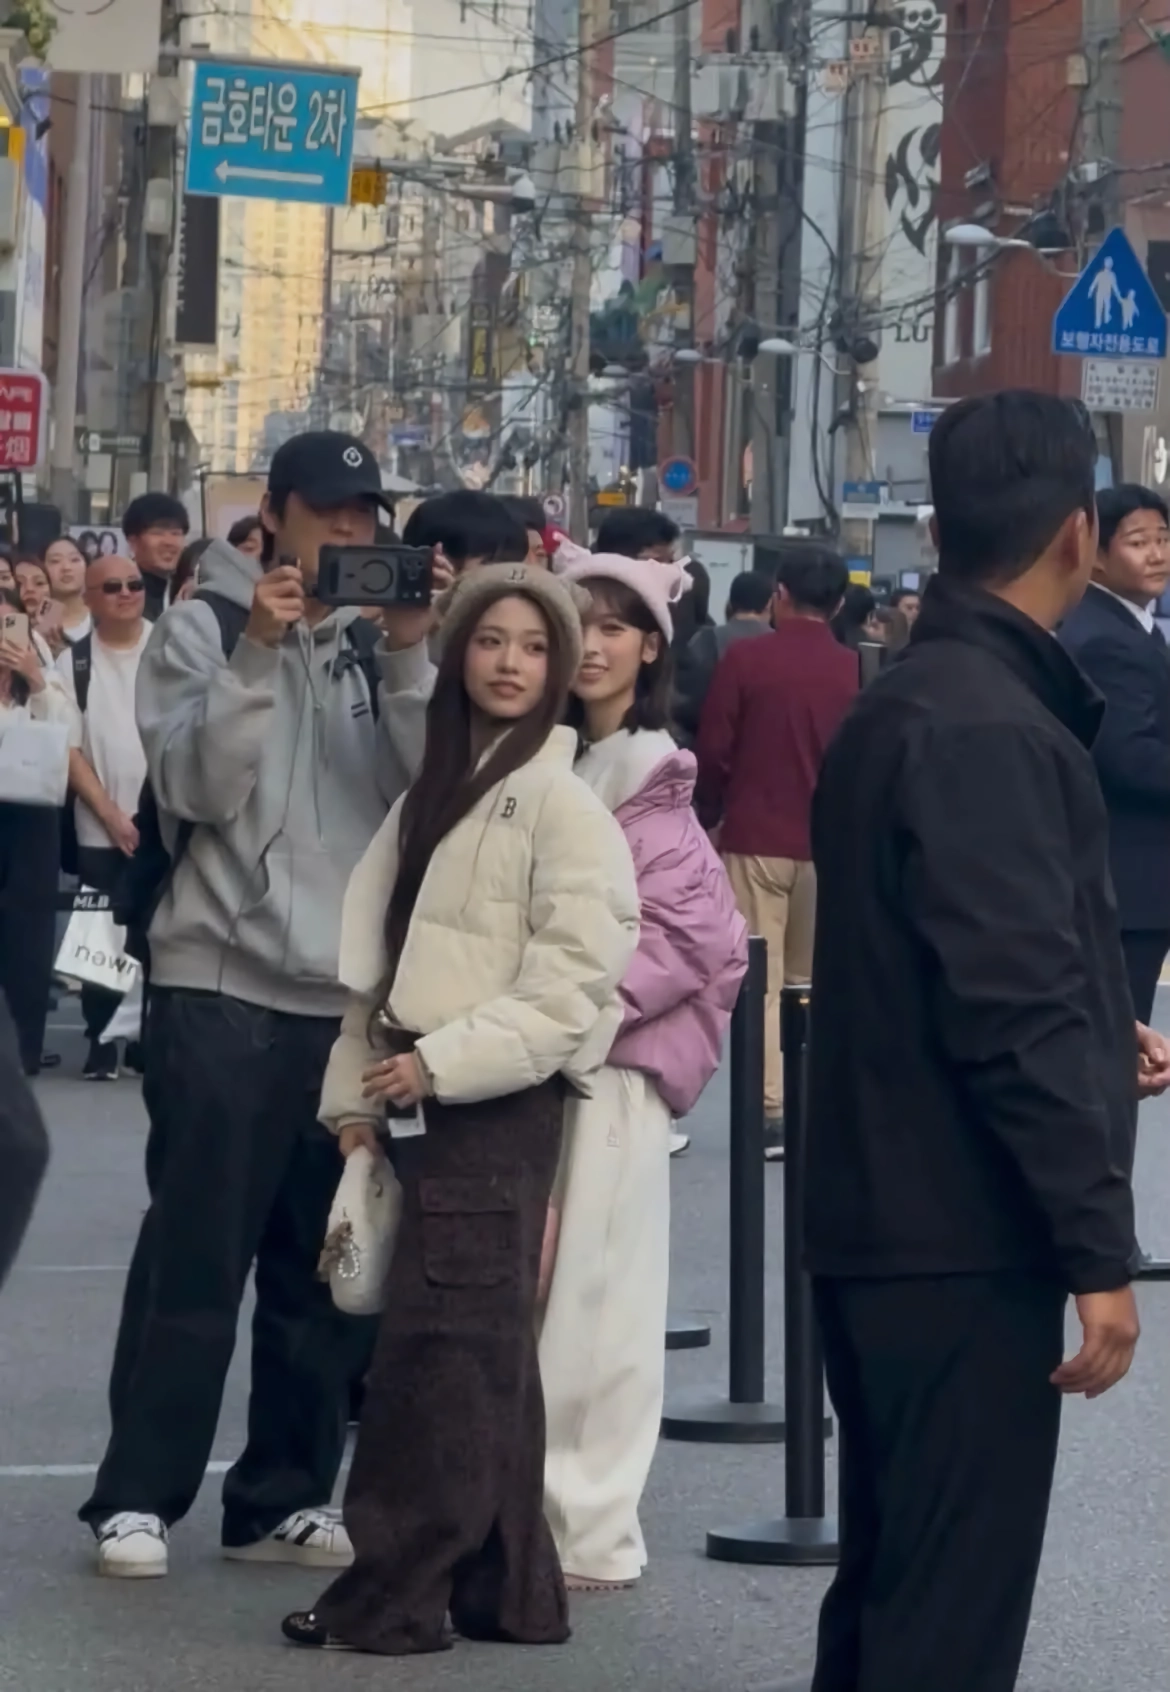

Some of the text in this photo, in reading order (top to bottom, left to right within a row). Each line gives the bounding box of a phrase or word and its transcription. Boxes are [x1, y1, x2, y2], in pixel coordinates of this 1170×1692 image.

[202, 77, 347, 158] 금호타운 2차
[500, 796, 518, 818] B
